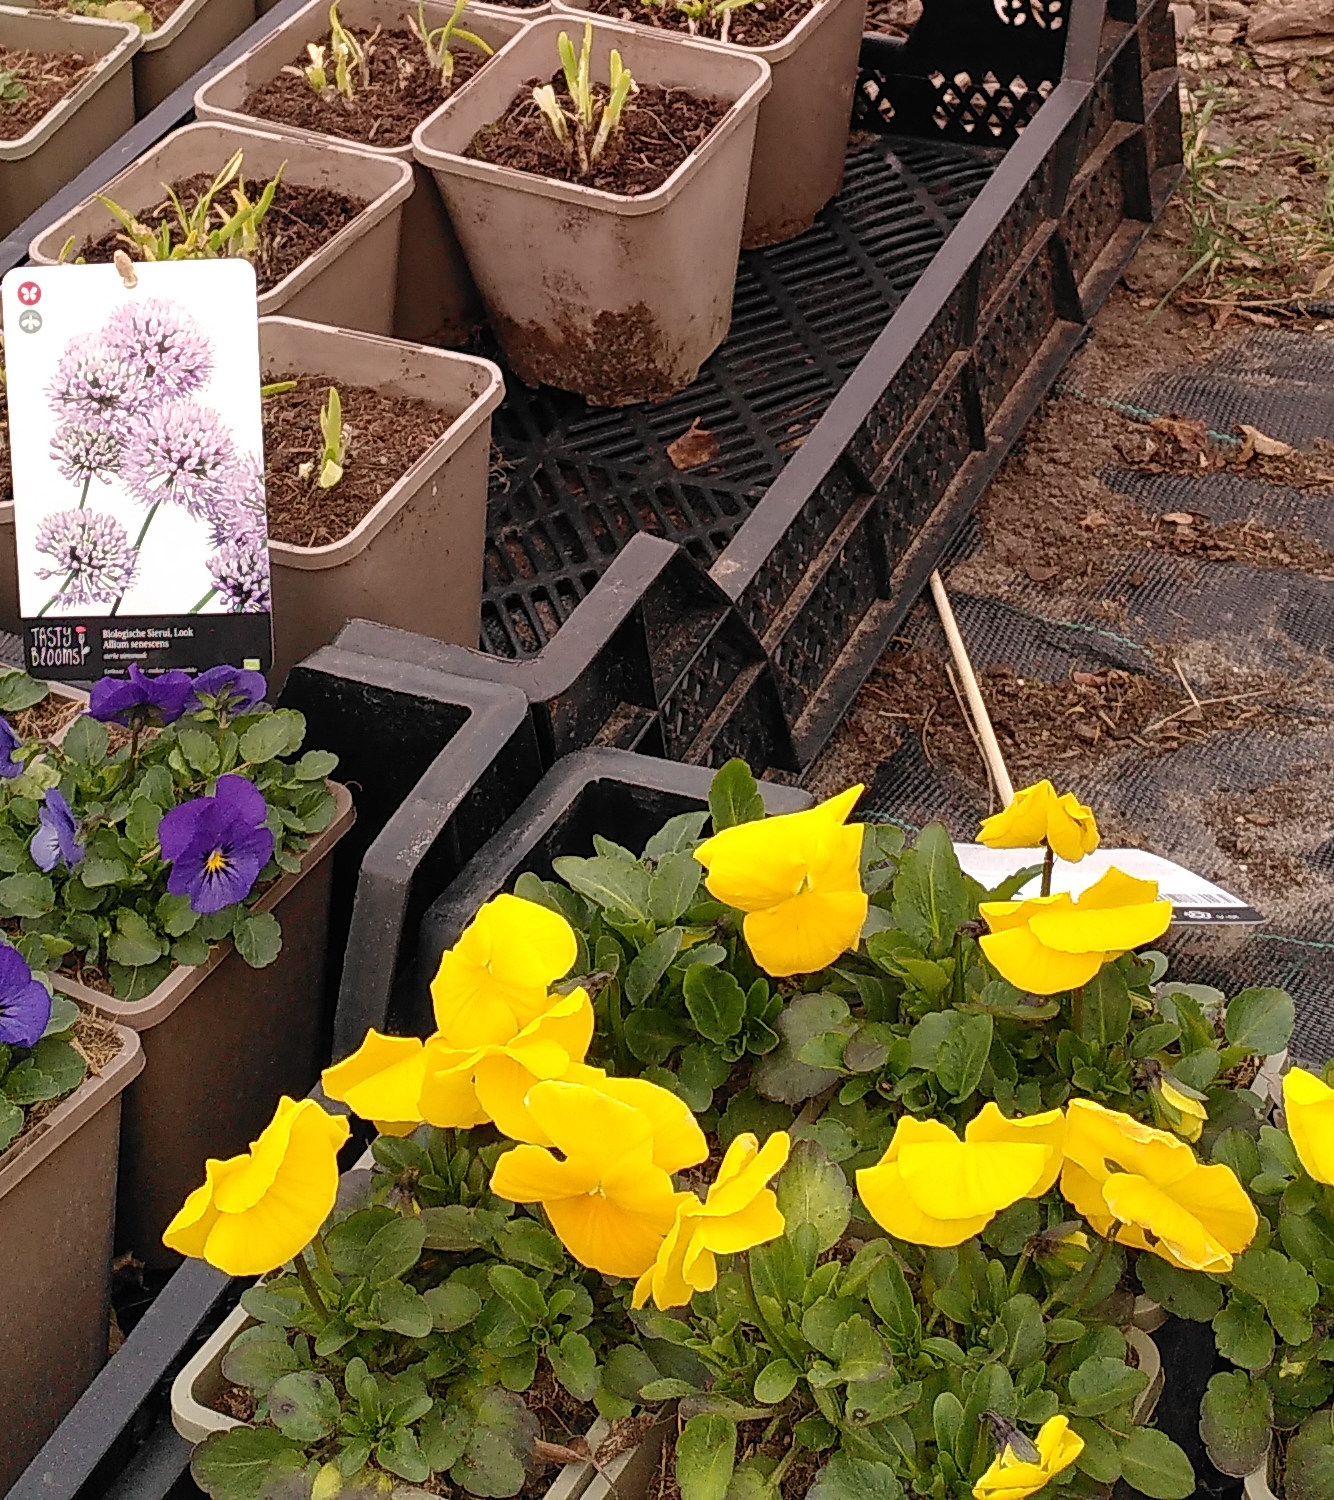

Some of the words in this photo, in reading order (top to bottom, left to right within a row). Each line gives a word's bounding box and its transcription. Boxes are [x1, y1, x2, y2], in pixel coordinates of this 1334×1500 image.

[30, 626, 72, 647] TASTY
[102, 628, 146, 640] Biologische
[173, 627, 194, 638] Look
[103, 639, 129, 649] Allium
[130, 640, 170, 649] senescens
